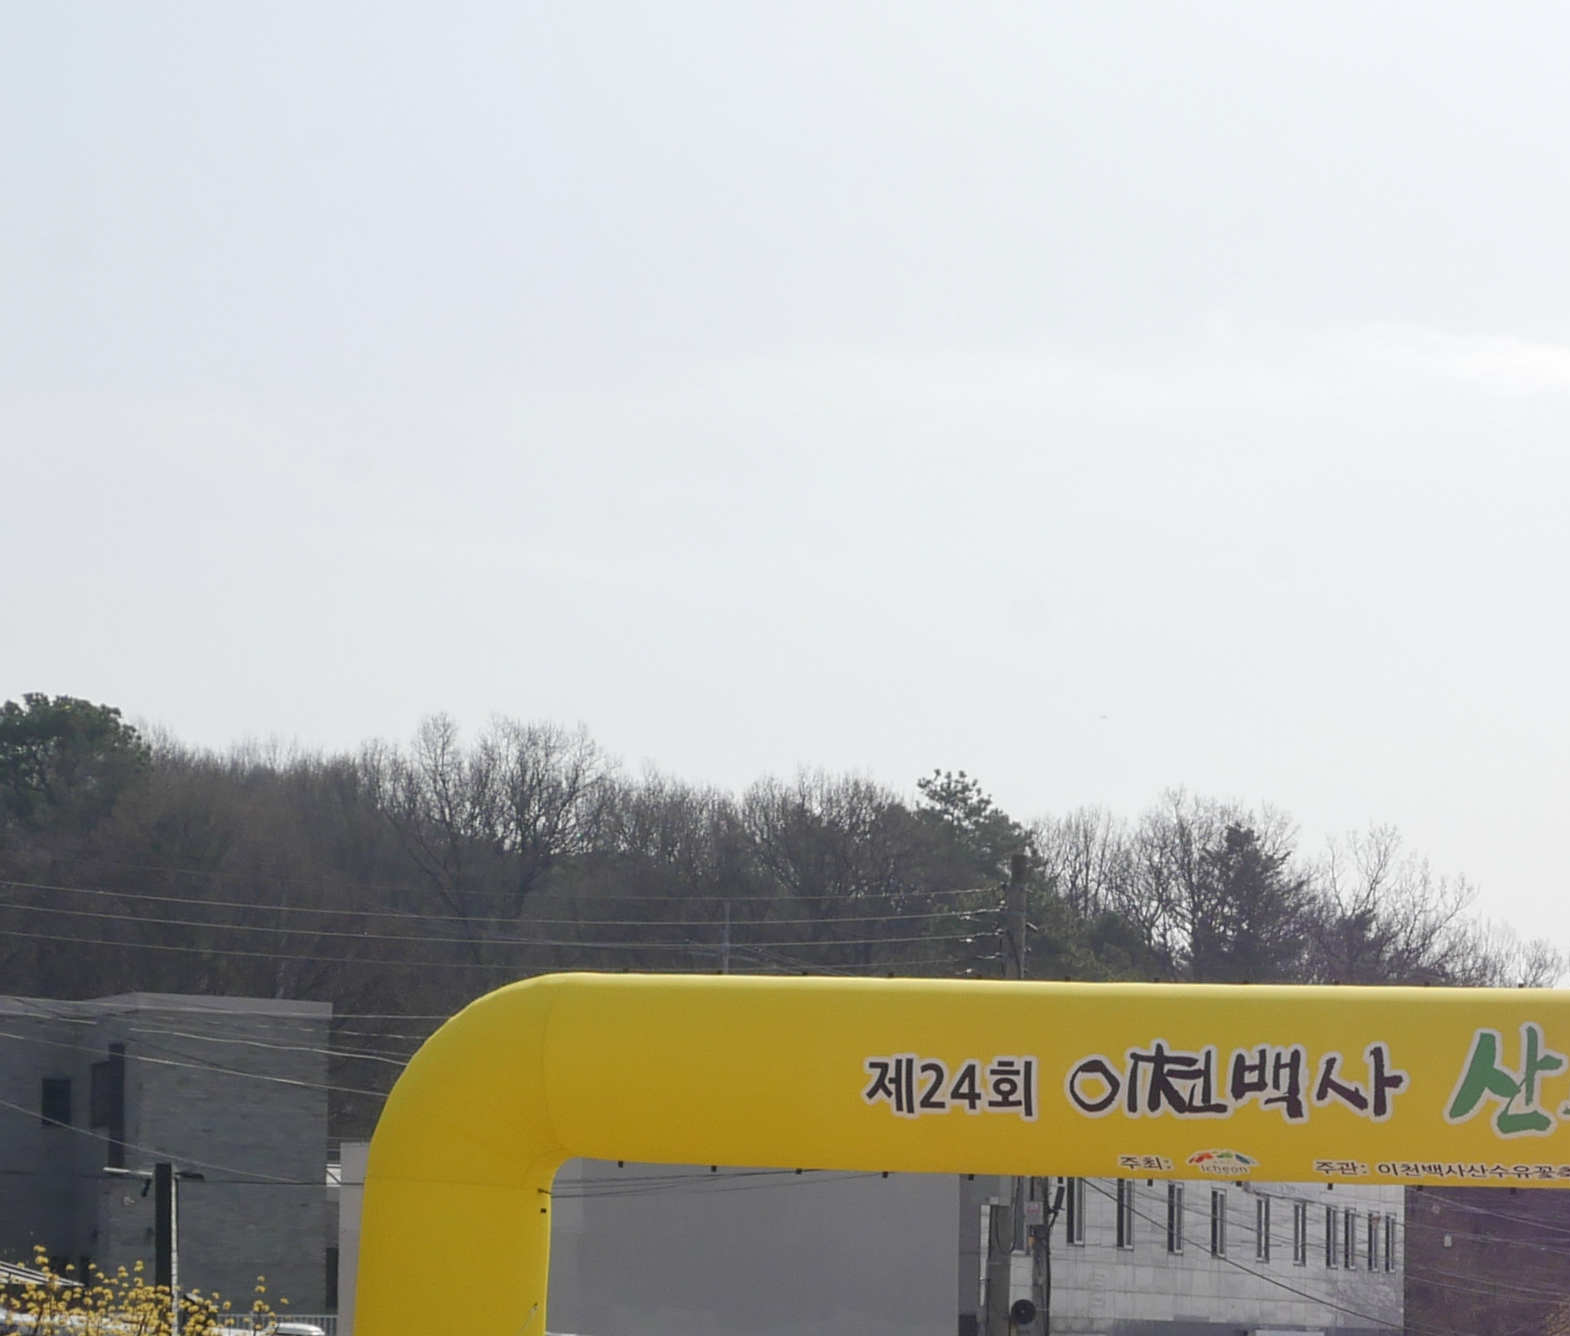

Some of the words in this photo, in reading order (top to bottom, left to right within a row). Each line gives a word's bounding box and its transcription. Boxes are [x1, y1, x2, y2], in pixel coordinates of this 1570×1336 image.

[866, 1056, 1034, 1118] 제24회
[1069, 1044, 1404, 1118] 이천백사
[1120, 1156, 1172, 1171] 주최:
[1201, 1164, 1249, 1174] Icheon
[1315, 1160, 1367, 1176] 주관:
